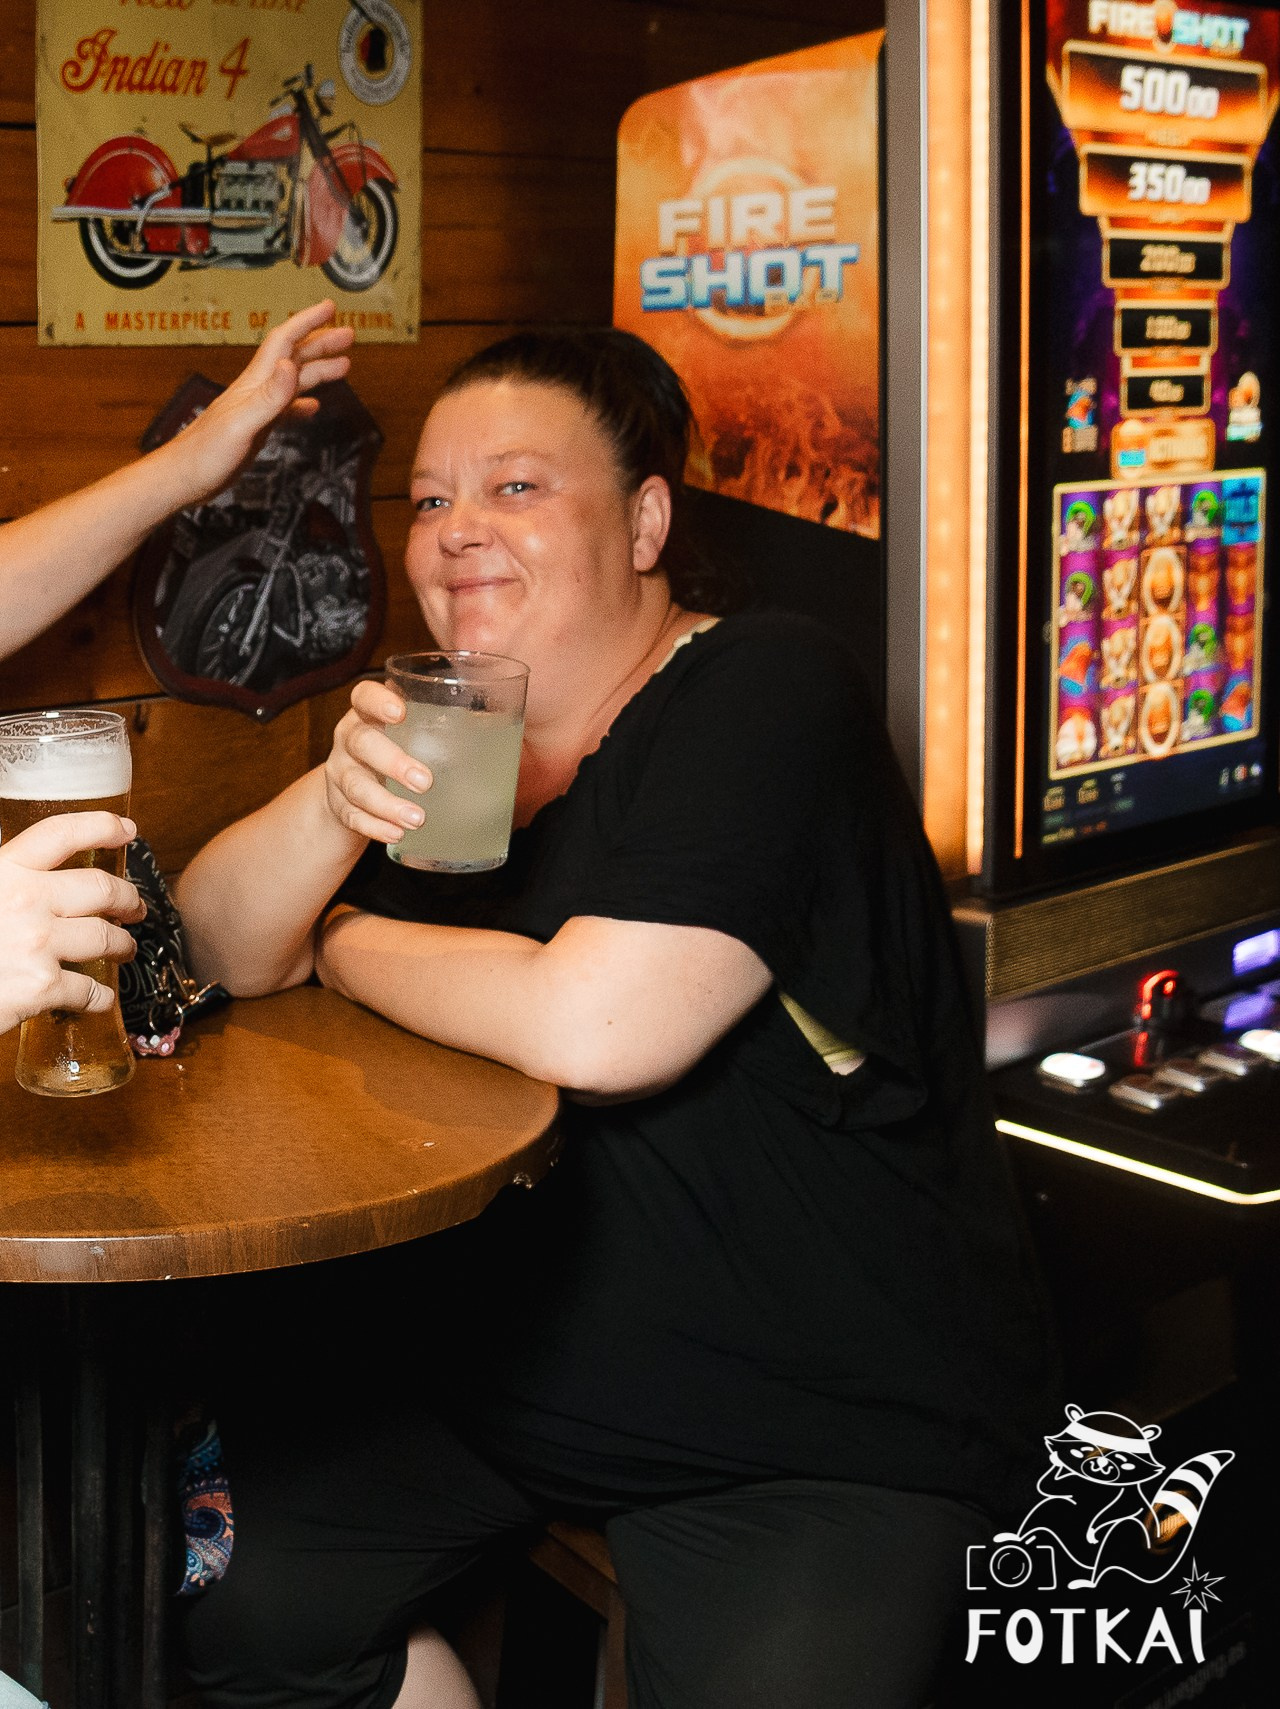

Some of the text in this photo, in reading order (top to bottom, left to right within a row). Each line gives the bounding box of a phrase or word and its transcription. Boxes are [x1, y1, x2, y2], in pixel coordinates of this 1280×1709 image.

[1088, 0, 1250, 50] FIRE SHOT
[61, 27, 251, 99] Indian 4
[658, 186, 839, 256] FIRE
[639, 244, 861, 312] SHOT
[74, 310, 86, 330] A
[104, 310, 232, 331] MASTERPIECE
[248, 310, 269, 330] OF
